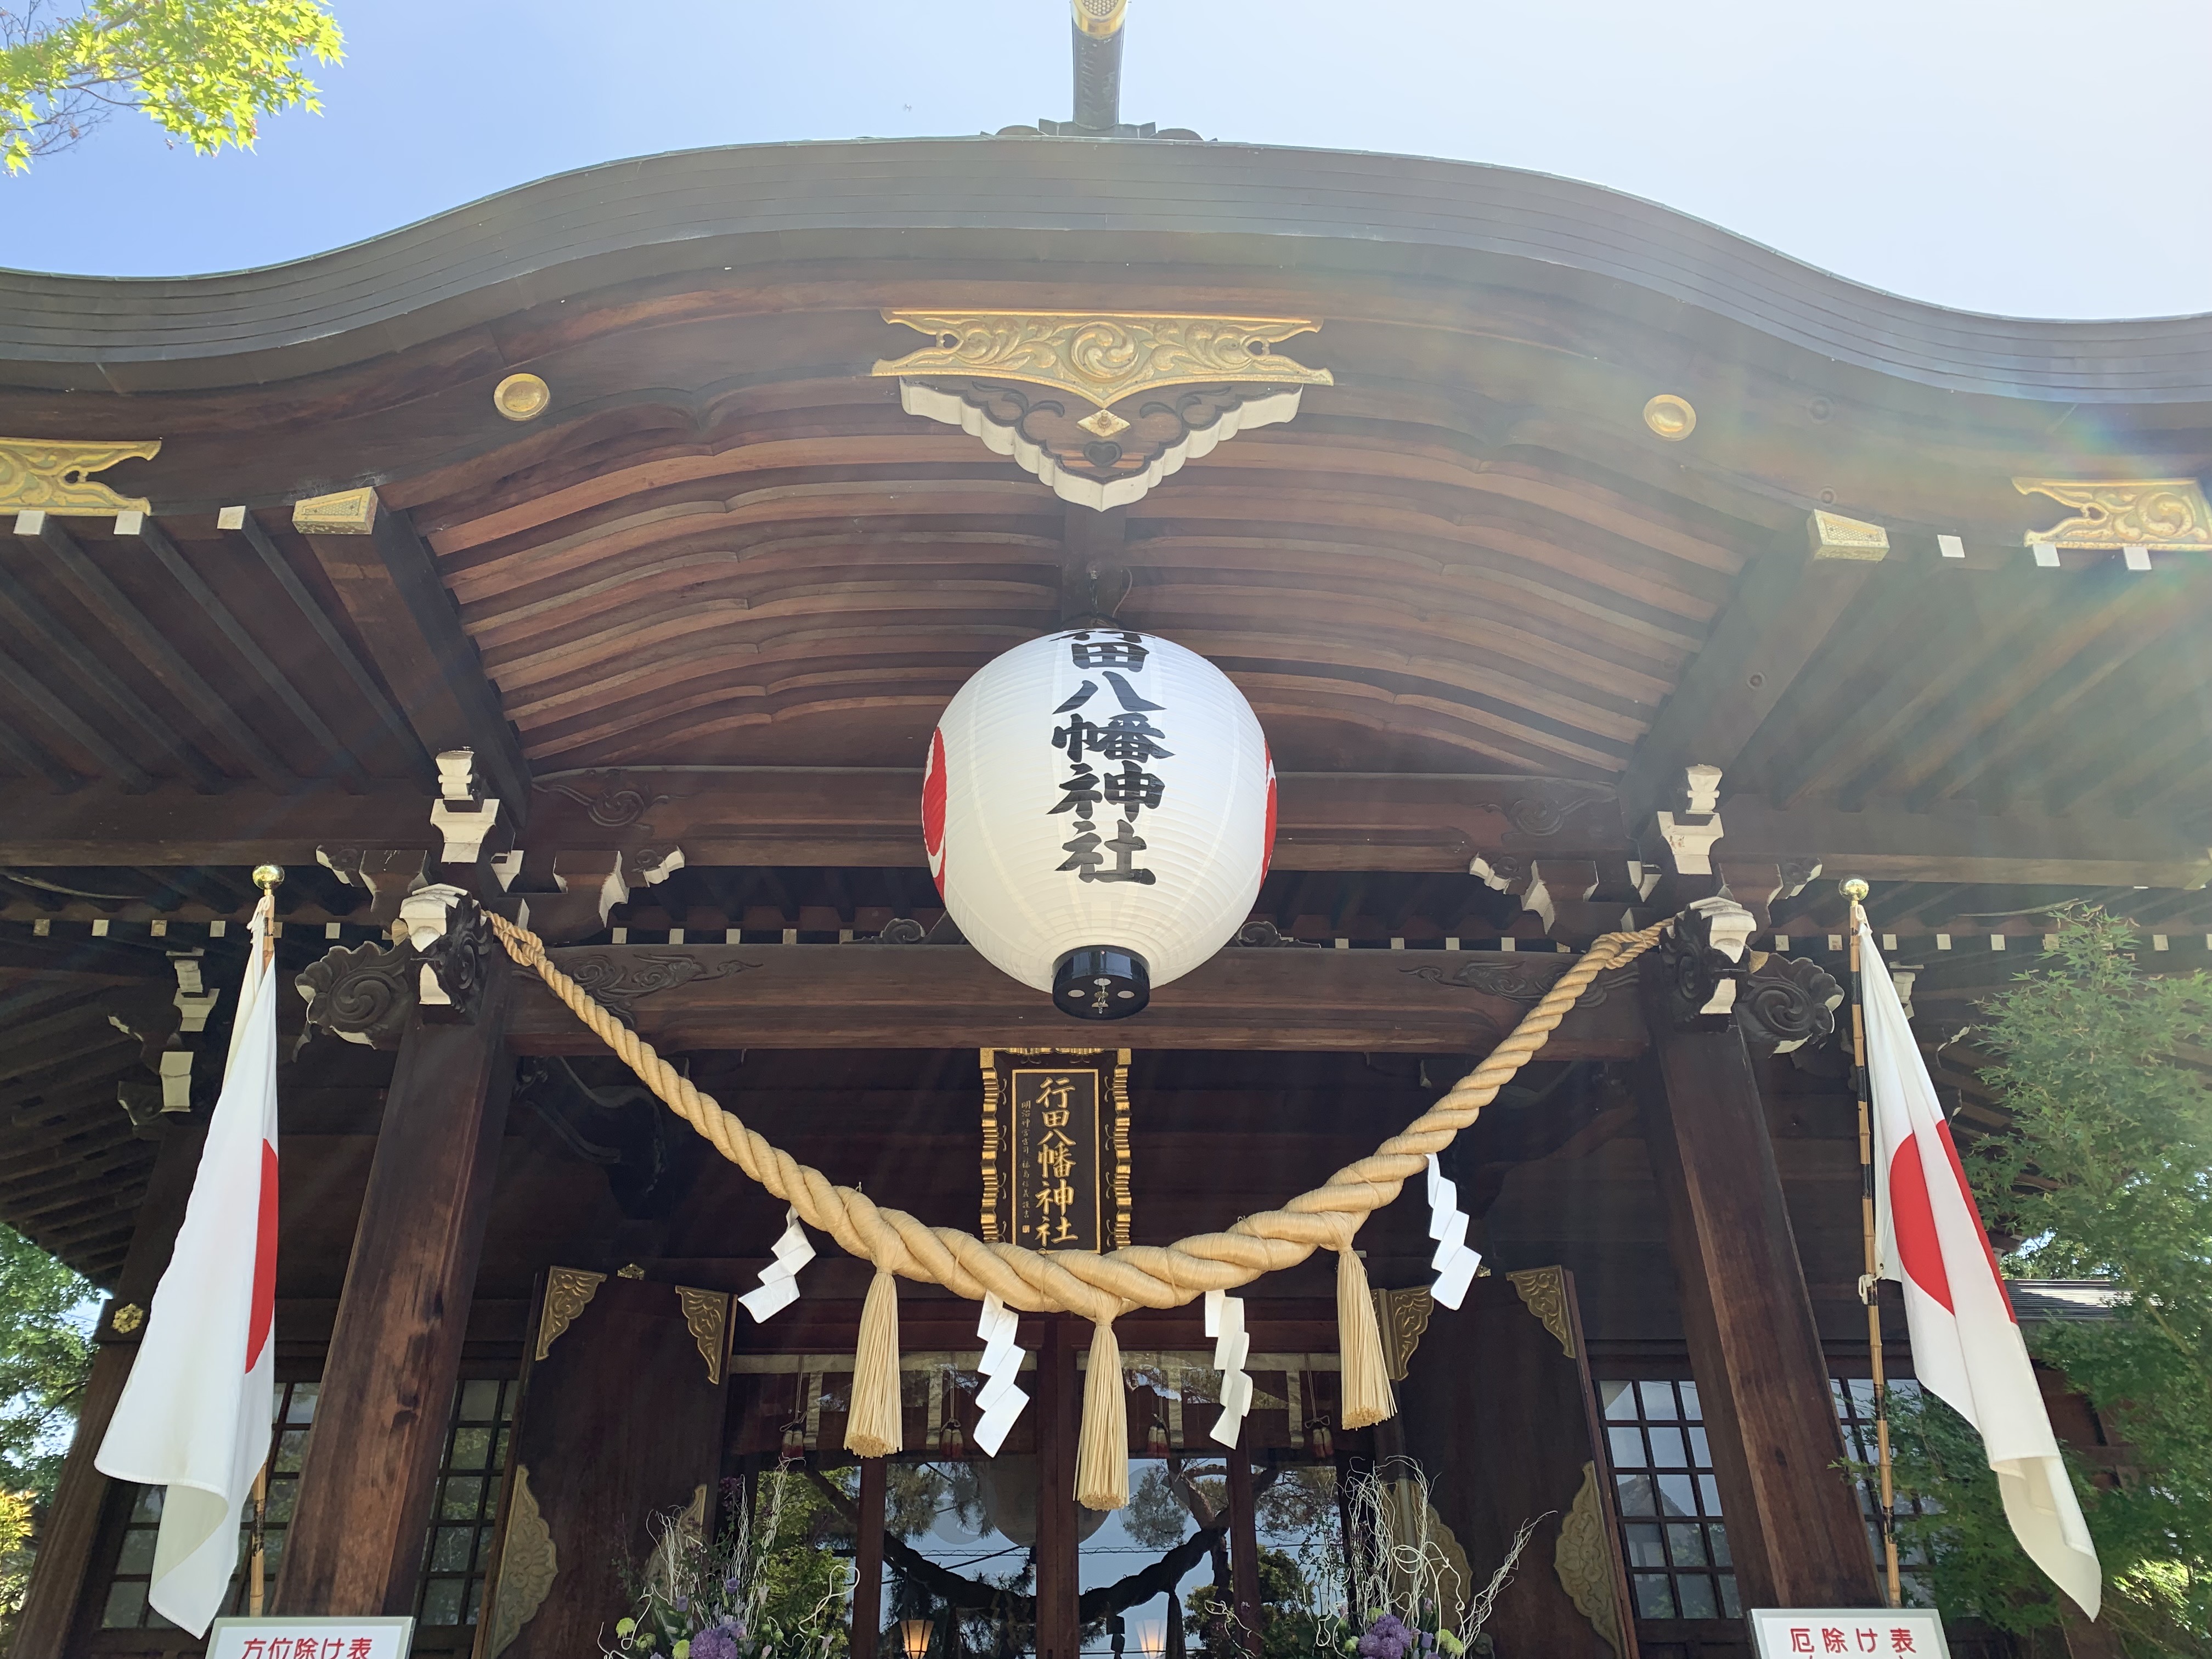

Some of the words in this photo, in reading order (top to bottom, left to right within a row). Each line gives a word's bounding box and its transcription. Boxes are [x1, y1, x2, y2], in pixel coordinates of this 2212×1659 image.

[1035, 1076, 1079, 1247] 行田八幡神社
[241, 1637, 373, 1659] 方位除け表
[1790, 1627, 1917, 1653] 厄除け表
